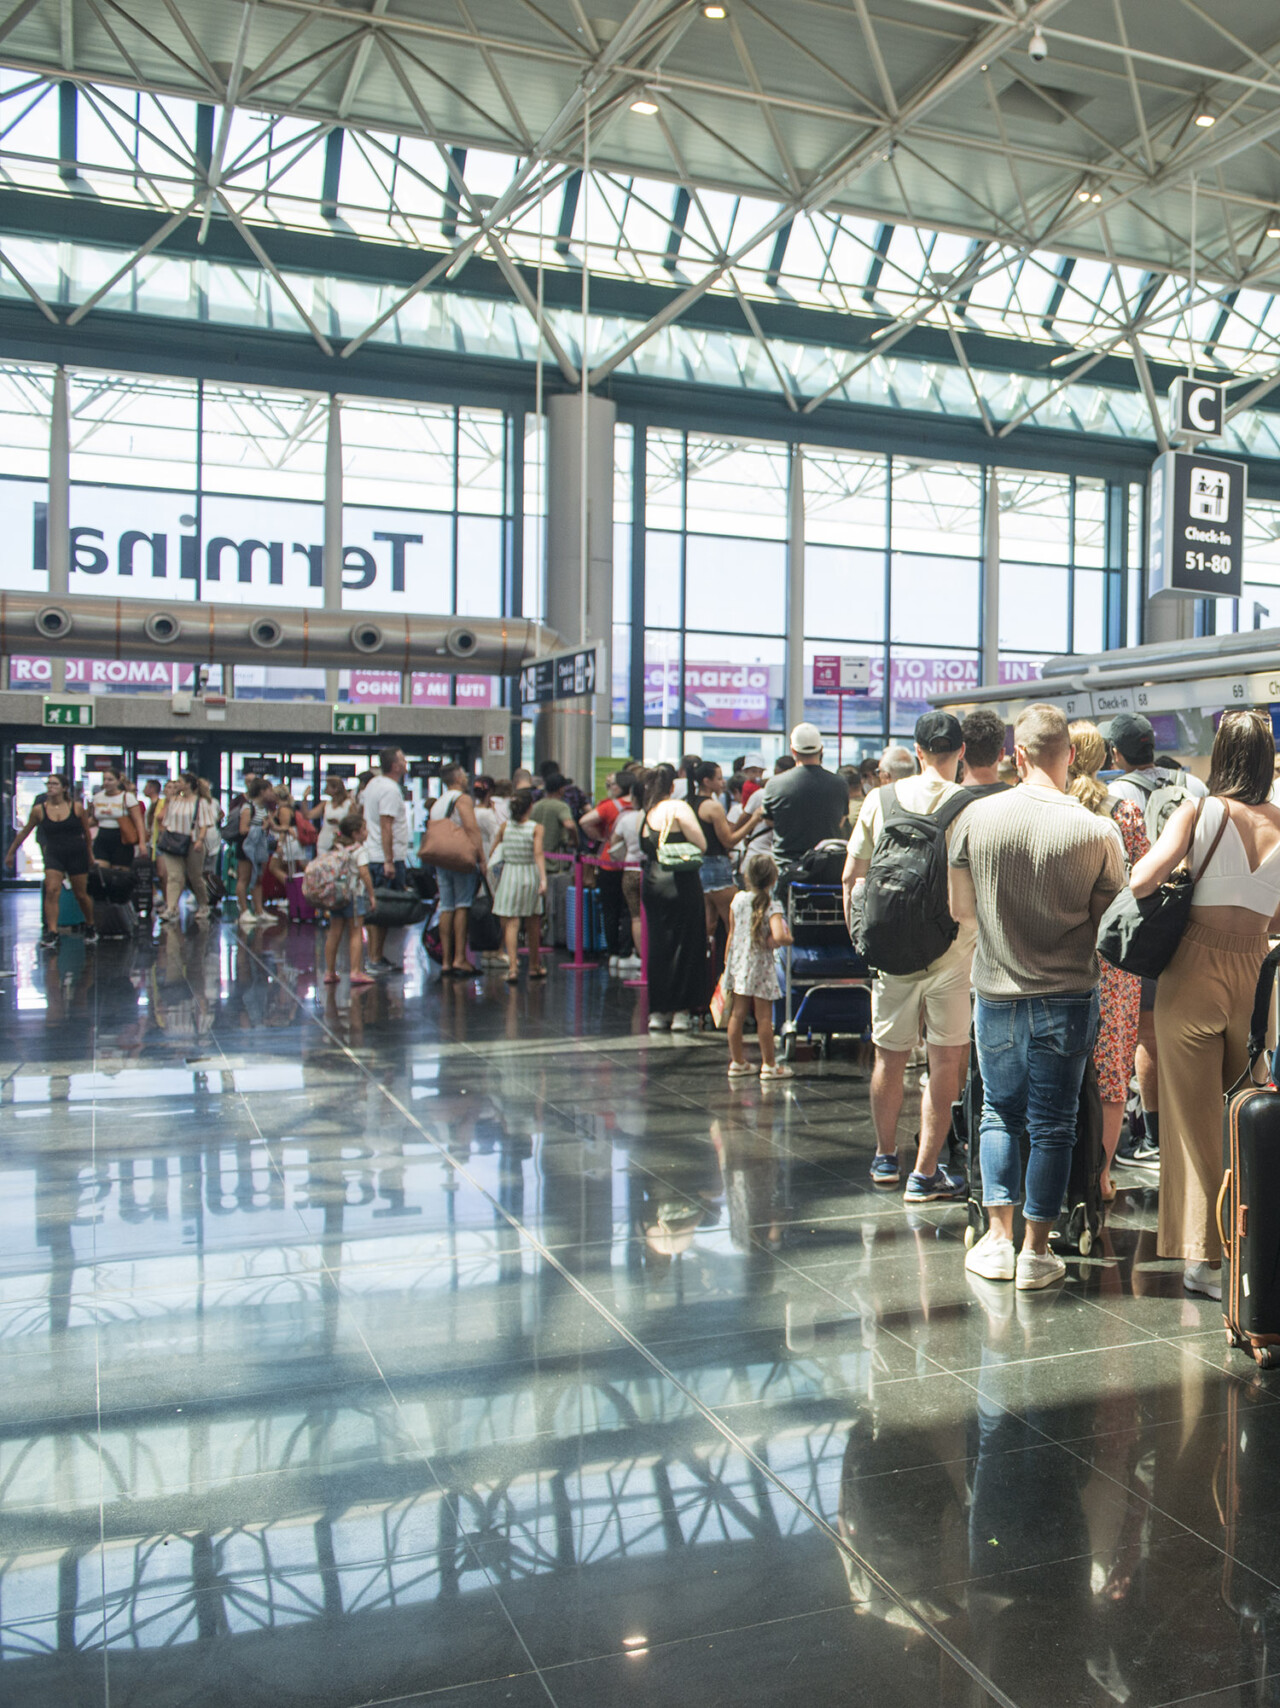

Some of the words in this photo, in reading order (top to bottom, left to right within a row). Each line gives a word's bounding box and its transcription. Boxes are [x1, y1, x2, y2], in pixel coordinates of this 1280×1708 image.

[1188, 387, 1216, 432] C
[1185, 526, 1231, 546] Check-in
[1185, 551, 1231, 575] 51-80
[11, 659, 52, 680] RO
[93, 661, 170, 683] ROMA
[895, 660, 926, 679] TO
[933, 661, 978, 680] ROM
[1005, 663, 1028, 681] IN
[356, 681, 401, 696] OGNI
[413, 682, 424, 696] 5
[427, 682, 486, 698] MIUTI
[1233, 684, 1244, 698] 69
[1067, 701, 1076, 714] 67
[1098, 696, 1128, 711] Check-in
[1138, 693, 1148, 706] 68
